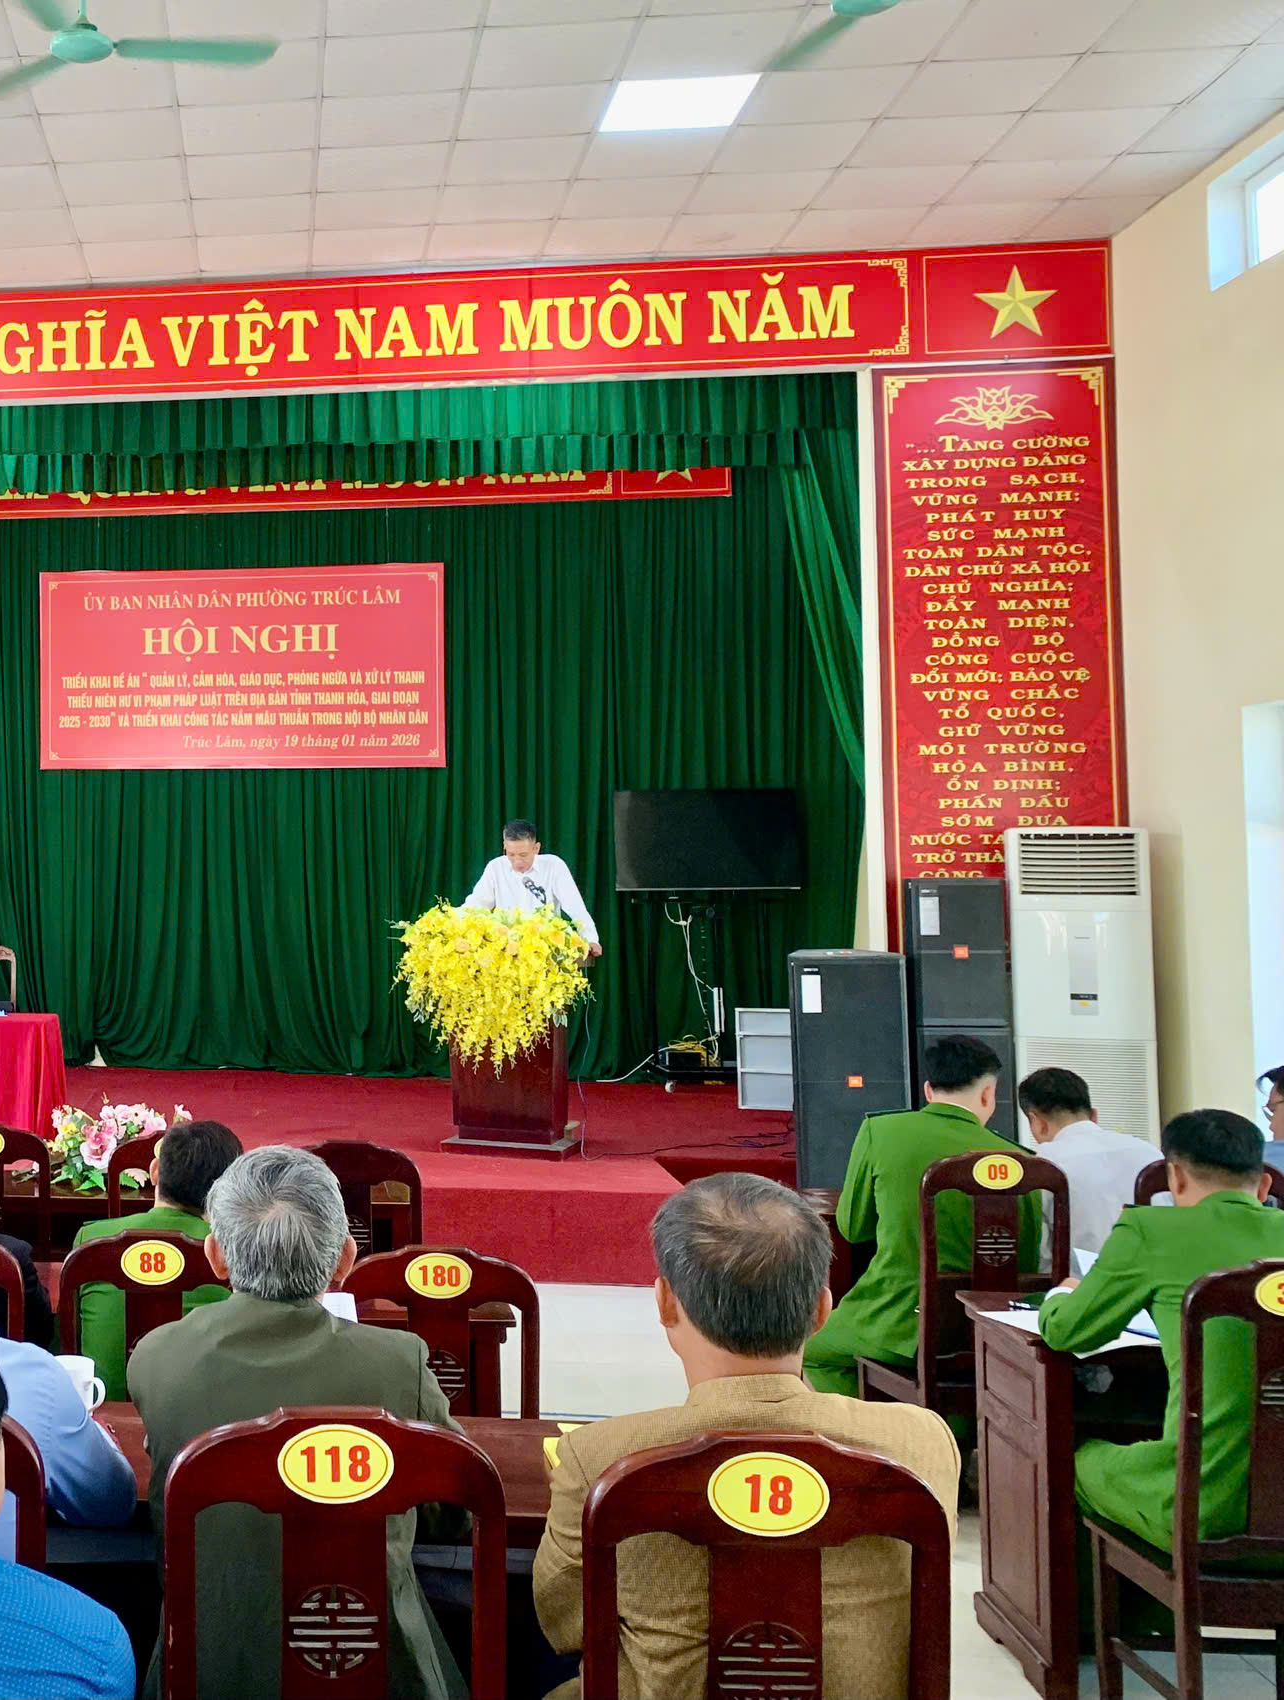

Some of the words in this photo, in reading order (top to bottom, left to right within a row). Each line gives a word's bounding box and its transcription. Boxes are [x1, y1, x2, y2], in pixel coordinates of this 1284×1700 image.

[161, 298, 319, 376] VIỆT
[335, 303, 479, 360] NAM
[499, 279, 687, 352] MUÔN
[707, 272, 855, 343] NĂM
[1012, 435, 1090, 449] CƯỜNG
[902, 458, 948, 471] XÂY
[953, 457, 1017, 471] DỰNG
[1023, 452, 1086, 467] ĐẢNG
[905, 476, 987, 488] TRONG
[911, 493, 978, 506] VỮNG
[926, 509, 995, 523] PHÁT
[1013, 509, 1065, 520] HUY
[993, 527, 1065, 540] MẠNH
[903, 546, 964, 559] TOÀN
[977, 544, 1025, 557] DÂN
[905, 564, 951, 577] DÂN
[957, 561, 1004, 576] CHỦ
[1011, 561, 1043, 574] XÃ
[1049, 559, 1090, 575] HỘI
[923, 580, 971, 594] CHỦ
[110, 596, 142, 610] BAN
[148, 590, 193, 609] NHÂN
[198, 589, 231, 608] DÂN
[236, 588, 306, 607] PHƯỜNG
[311, 586, 357, 605] TRÚC
[363, 585, 400, 604] LÂM
[997, 598, 1070, 612] MẠNH
[924, 616, 986, 630] TOÀN
[143, 618, 218, 662] HỘI
[231, 624, 338, 660] NGHỊ
[1033, 632, 1064, 647] BỘ
[925, 652, 988, 666] CÔNG
[1011, 650, 1074, 665] CUỘC
[90, 676, 110, 688] KHAI
[394, 671, 424, 683] THANH
[1010, 667, 1054, 681] BẢO
[1060, 667, 1090, 683] VỆ
[133, 695, 142, 707] VI
[314, 692, 344, 704] THANH
[372, 692, 390, 704] GIAI
[923, 688, 990, 701] VỮNG
[59, 716, 80, 728] 2025
[161, 715, 181, 726] KHAI
[312, 712, 342, 724] TRONG
[996, 723, 1064, 736] VỮNG
[285, 735, 298, 747] 19
[342, 734, 355, 746] 01
[391, 734, 420, 746] 2026
[919, 742, 966, 755] MÔI
[984, 740, 1086, 754] TRƯỜNG
[933, 760, 987, 773] HÒA
[941, 813, 994, 827] SỚM
[1017, 814, 1068, 826] ĐƯA
[910, 832, 971, 845] NƯỚC
[912, 849, 956, 863] TRỞ
[988, 1164, 1008, 1180] 09
[140, 1252, 166, 1273] 88
[417, 1263, 462, 1288] 180
[300, 1445, 371, 1483] 118
[745, 1474, 793, 1516] 18
